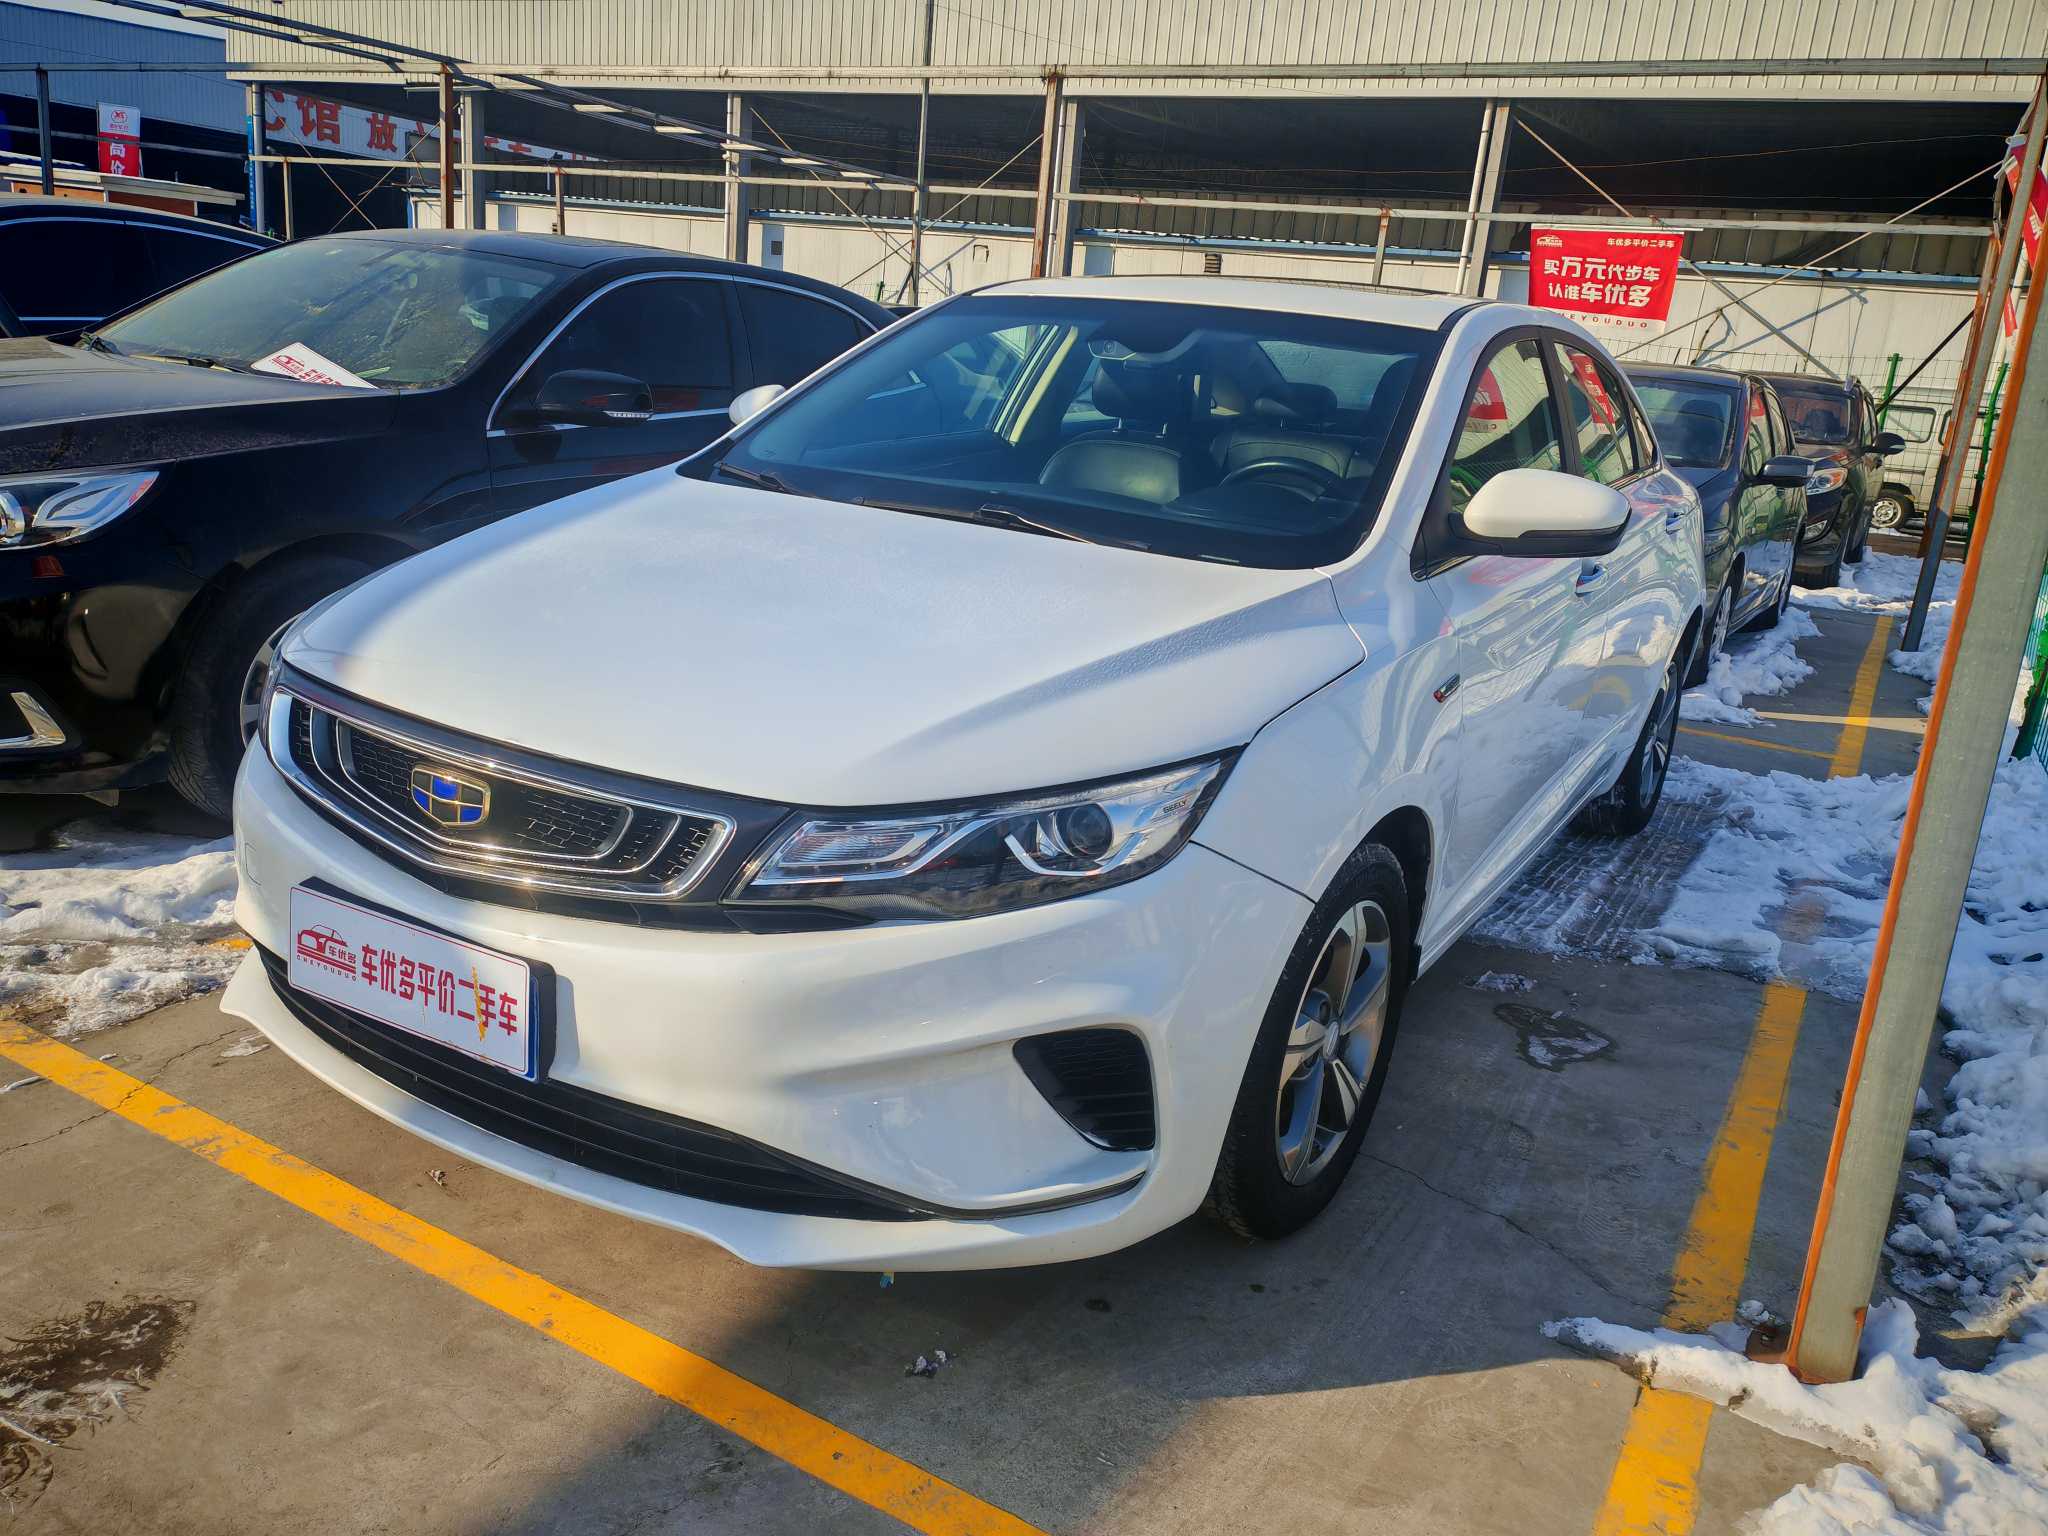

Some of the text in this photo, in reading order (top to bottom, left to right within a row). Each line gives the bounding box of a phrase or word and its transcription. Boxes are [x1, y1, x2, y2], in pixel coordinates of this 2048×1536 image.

[1607, 237, 1676, 249] 车优多平价二手车
[1543, 256, 1661, 282] 买万元代步车
[1548, 281, 1653, 307] 认准车优多
[328, 945, 357, 965] 车优多
[361, 943, 518, 1036] 车优多平价二手车
